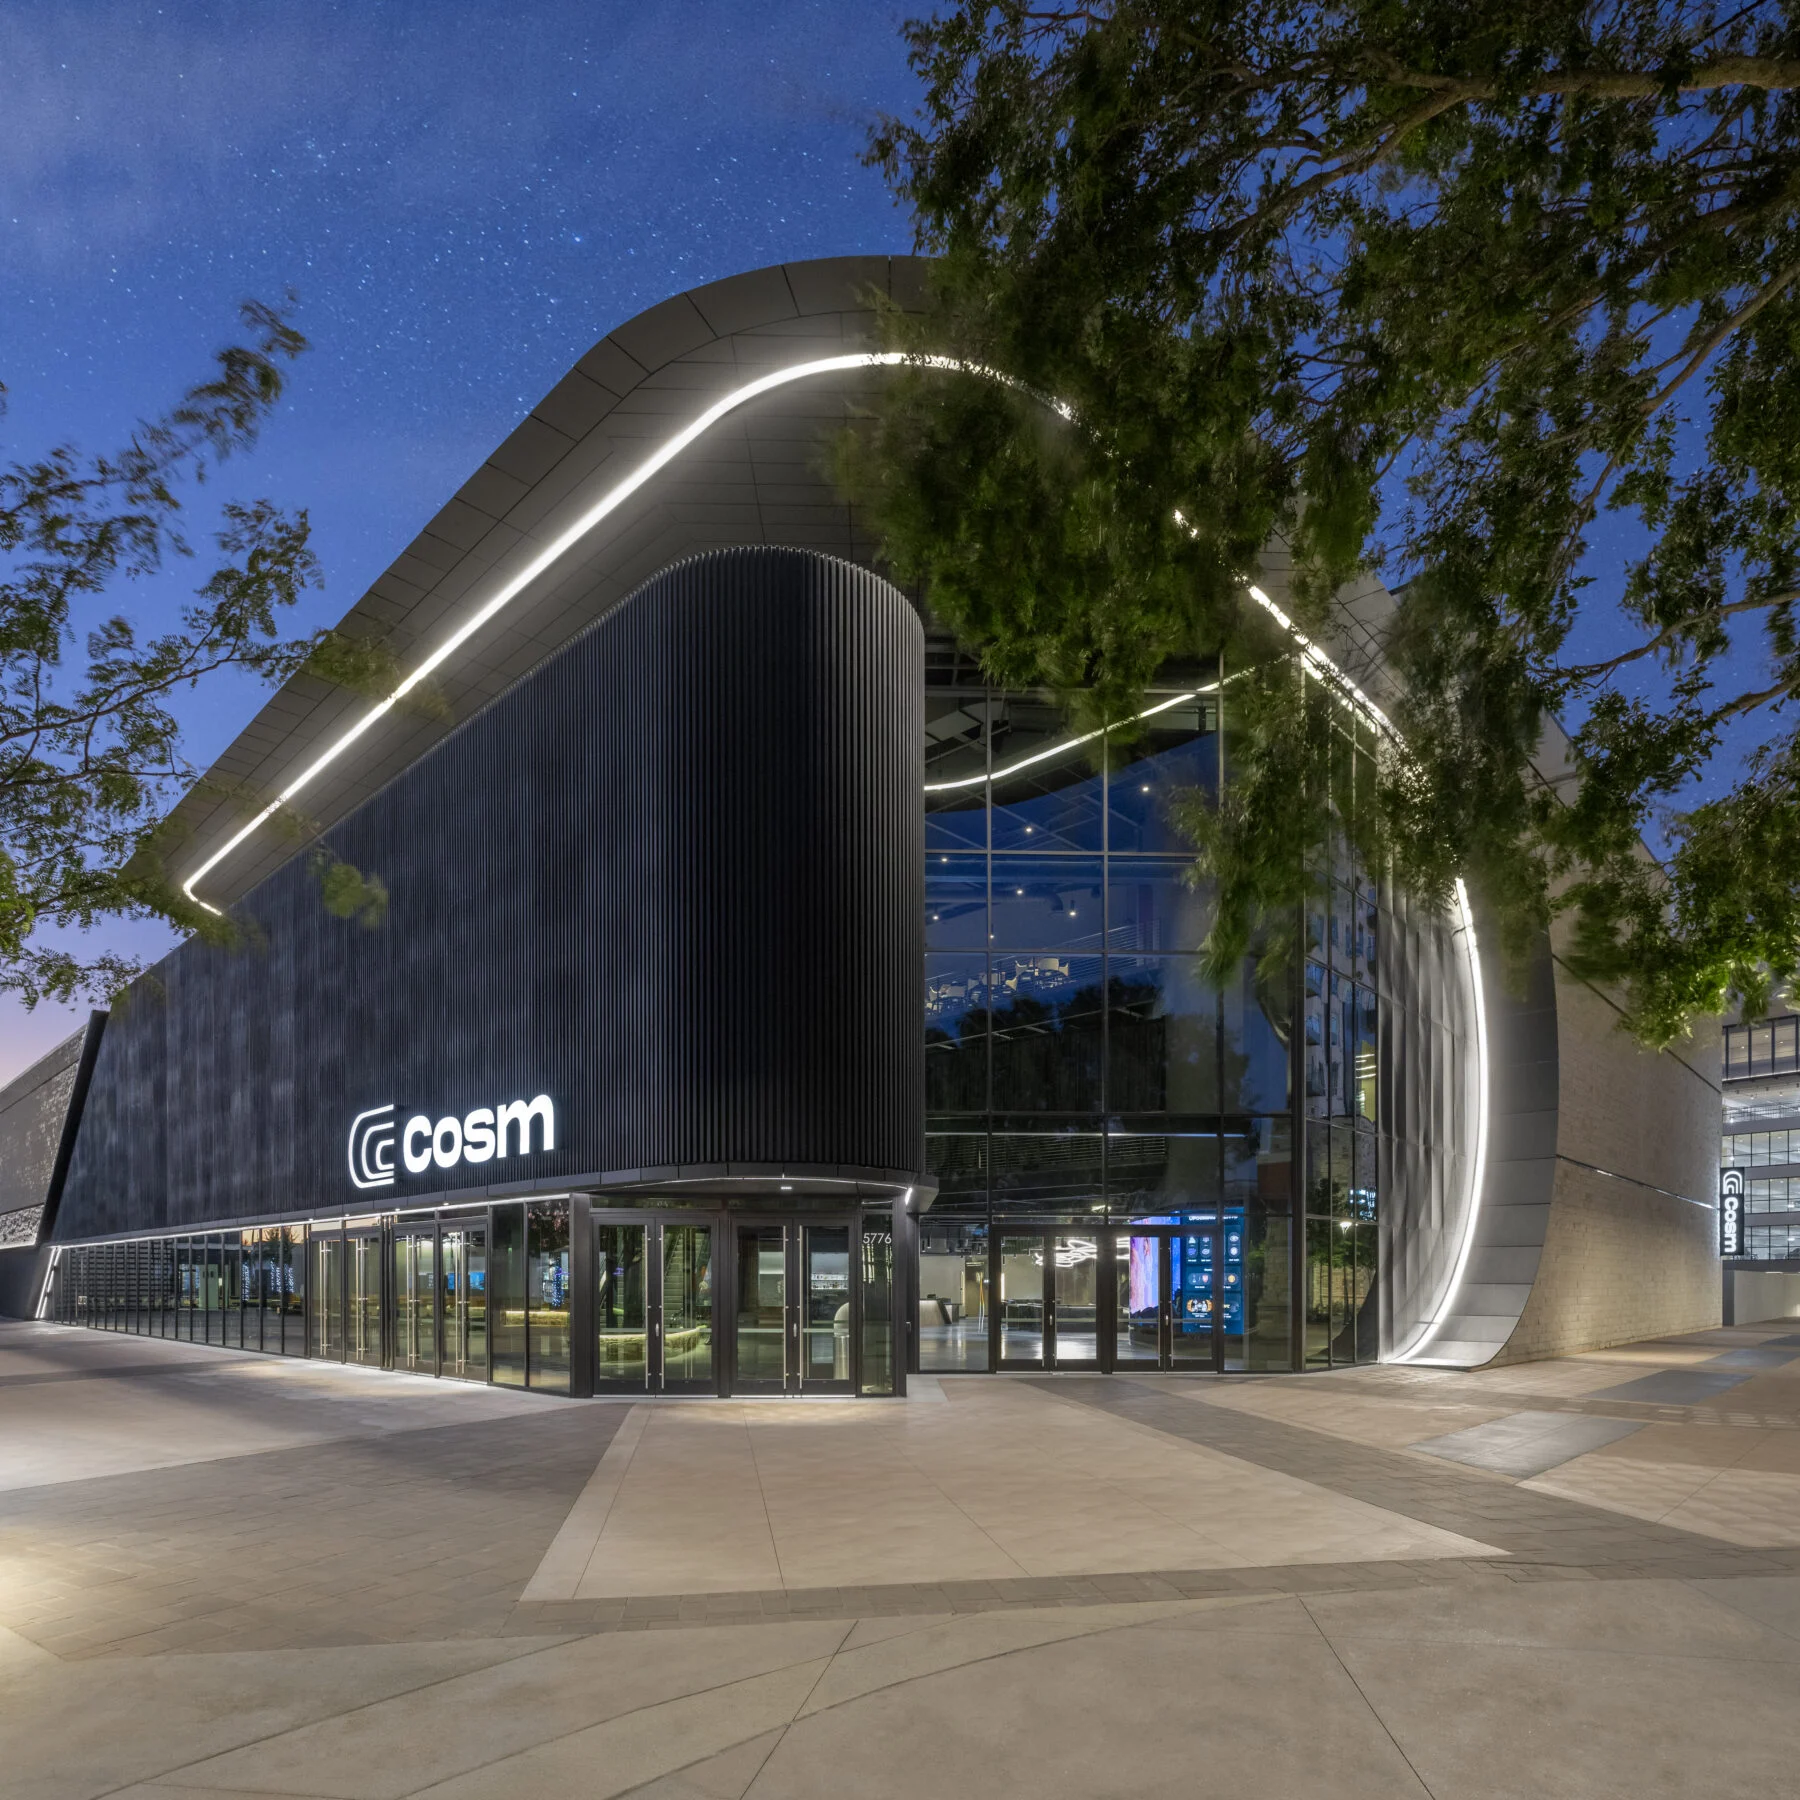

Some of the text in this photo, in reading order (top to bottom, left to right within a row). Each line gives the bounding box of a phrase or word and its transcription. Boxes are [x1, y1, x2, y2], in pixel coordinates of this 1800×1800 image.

[403, 1094, 554, 1173] cosm
[862, 1232, 892, 1244] 5776
[1724, 1196, 1739, 1253] cosm
